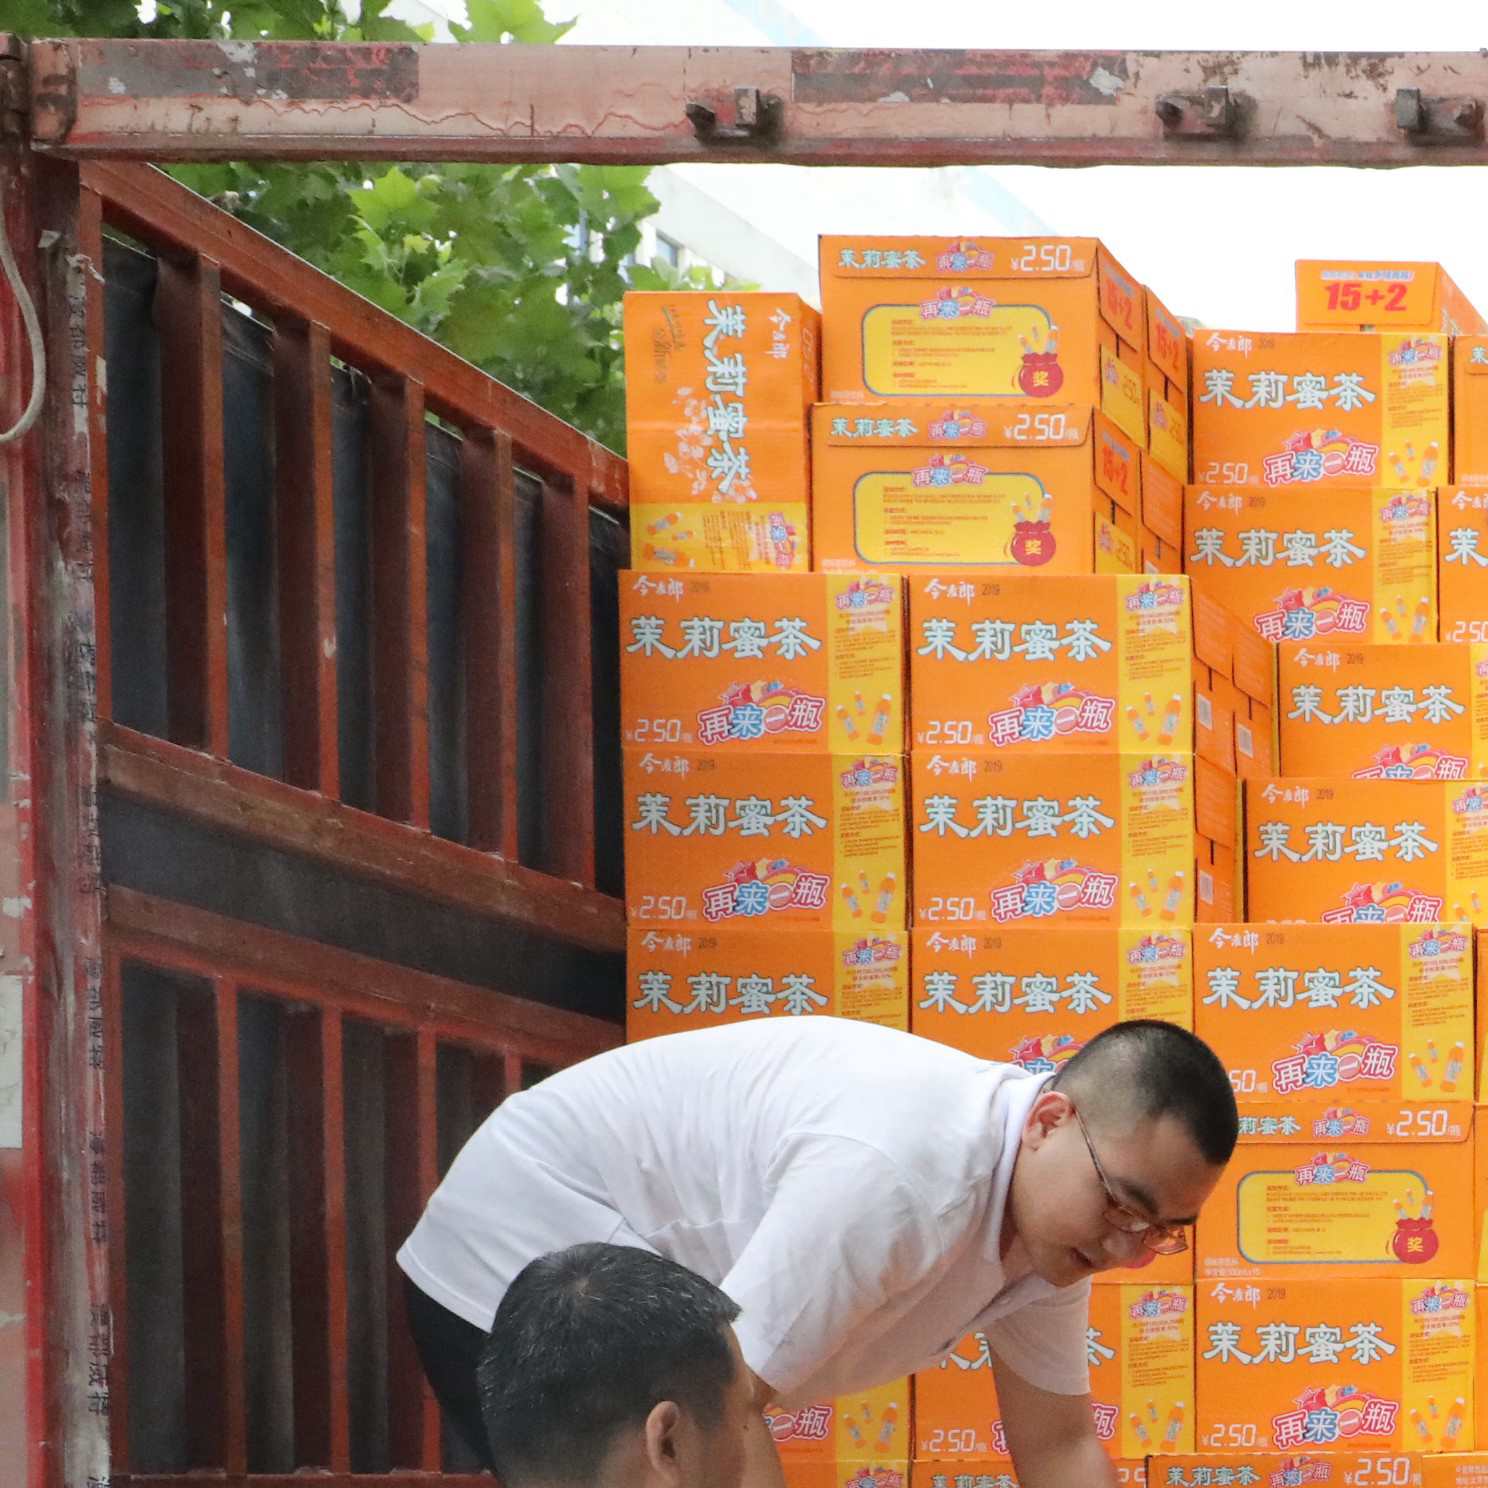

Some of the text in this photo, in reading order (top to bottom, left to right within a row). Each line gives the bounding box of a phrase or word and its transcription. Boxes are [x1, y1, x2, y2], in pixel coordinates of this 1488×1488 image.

[839, 249, 924, 270] 茉莉蜜茶
[920, 297, 995, 320] 再来一瓶
[1325, 283, 1408, 312] 15+2
[704, 300, 748, 494] 茉莉蜜茶
[1031, 371, 1049, 388] 奖
[1200, 369, 1376, 410] 茉莉蜜茶
[831, 418, 918, 438] 茉莉蜜茶
[911, 465, 989, 487] 再来一瓶
[1264, 442, 1378, 486] 再来一瓶
[1024, 539, 1041, 557] 奖
[1191, 528, 1367, 568] 茉莉蜜茶
[626, 615, 821, 661] 茉莉蜜茶
[917, 617, 1111, 662] 茉莉蜜茶
[1254, 601, 1369, 641] 再来一瓶
[698, 696, 825, 745] 再来一瓶
[988, 697, 1115, 746] 再来一瓶
[1287, 685, 1465, 725] 茉莉蜜茶
[631, 794, 827, 838] 茉莉蜜茶
[920, 795, 1114, 839] 茉莉蜜茶
[1254, 822, 1439, 863] 茉莉蜜茶
[702, 872, 831, 923] 再来一瓶
[991, 874, 1118, 923] 再来一瓶
[634, 971, 827, 1015] 茉莉蜜茶
[920, 971, 1111, 1015] 茉莉蜜茶
[1203, 967, 1395, 1010] 茉莉蜜茶
[1272, 1043, 1399, 1095] 再来一瓶
[1238, 1116, 1301, 1135] 莉蜜茶
[1313, 1116, 1370, 1137] 再来一瓶
[1295, 1161, 1369, 1186] 再来一瓶
[1407, 1237, 1424, 1254] 奖
[1203, 1324, 1396, 1365] 茉莉蜜茶
[1272, 1401, 1400, 1450] 再来一瓶
[1167, 1466, 1262, 1487] 茉莉蜜茶
